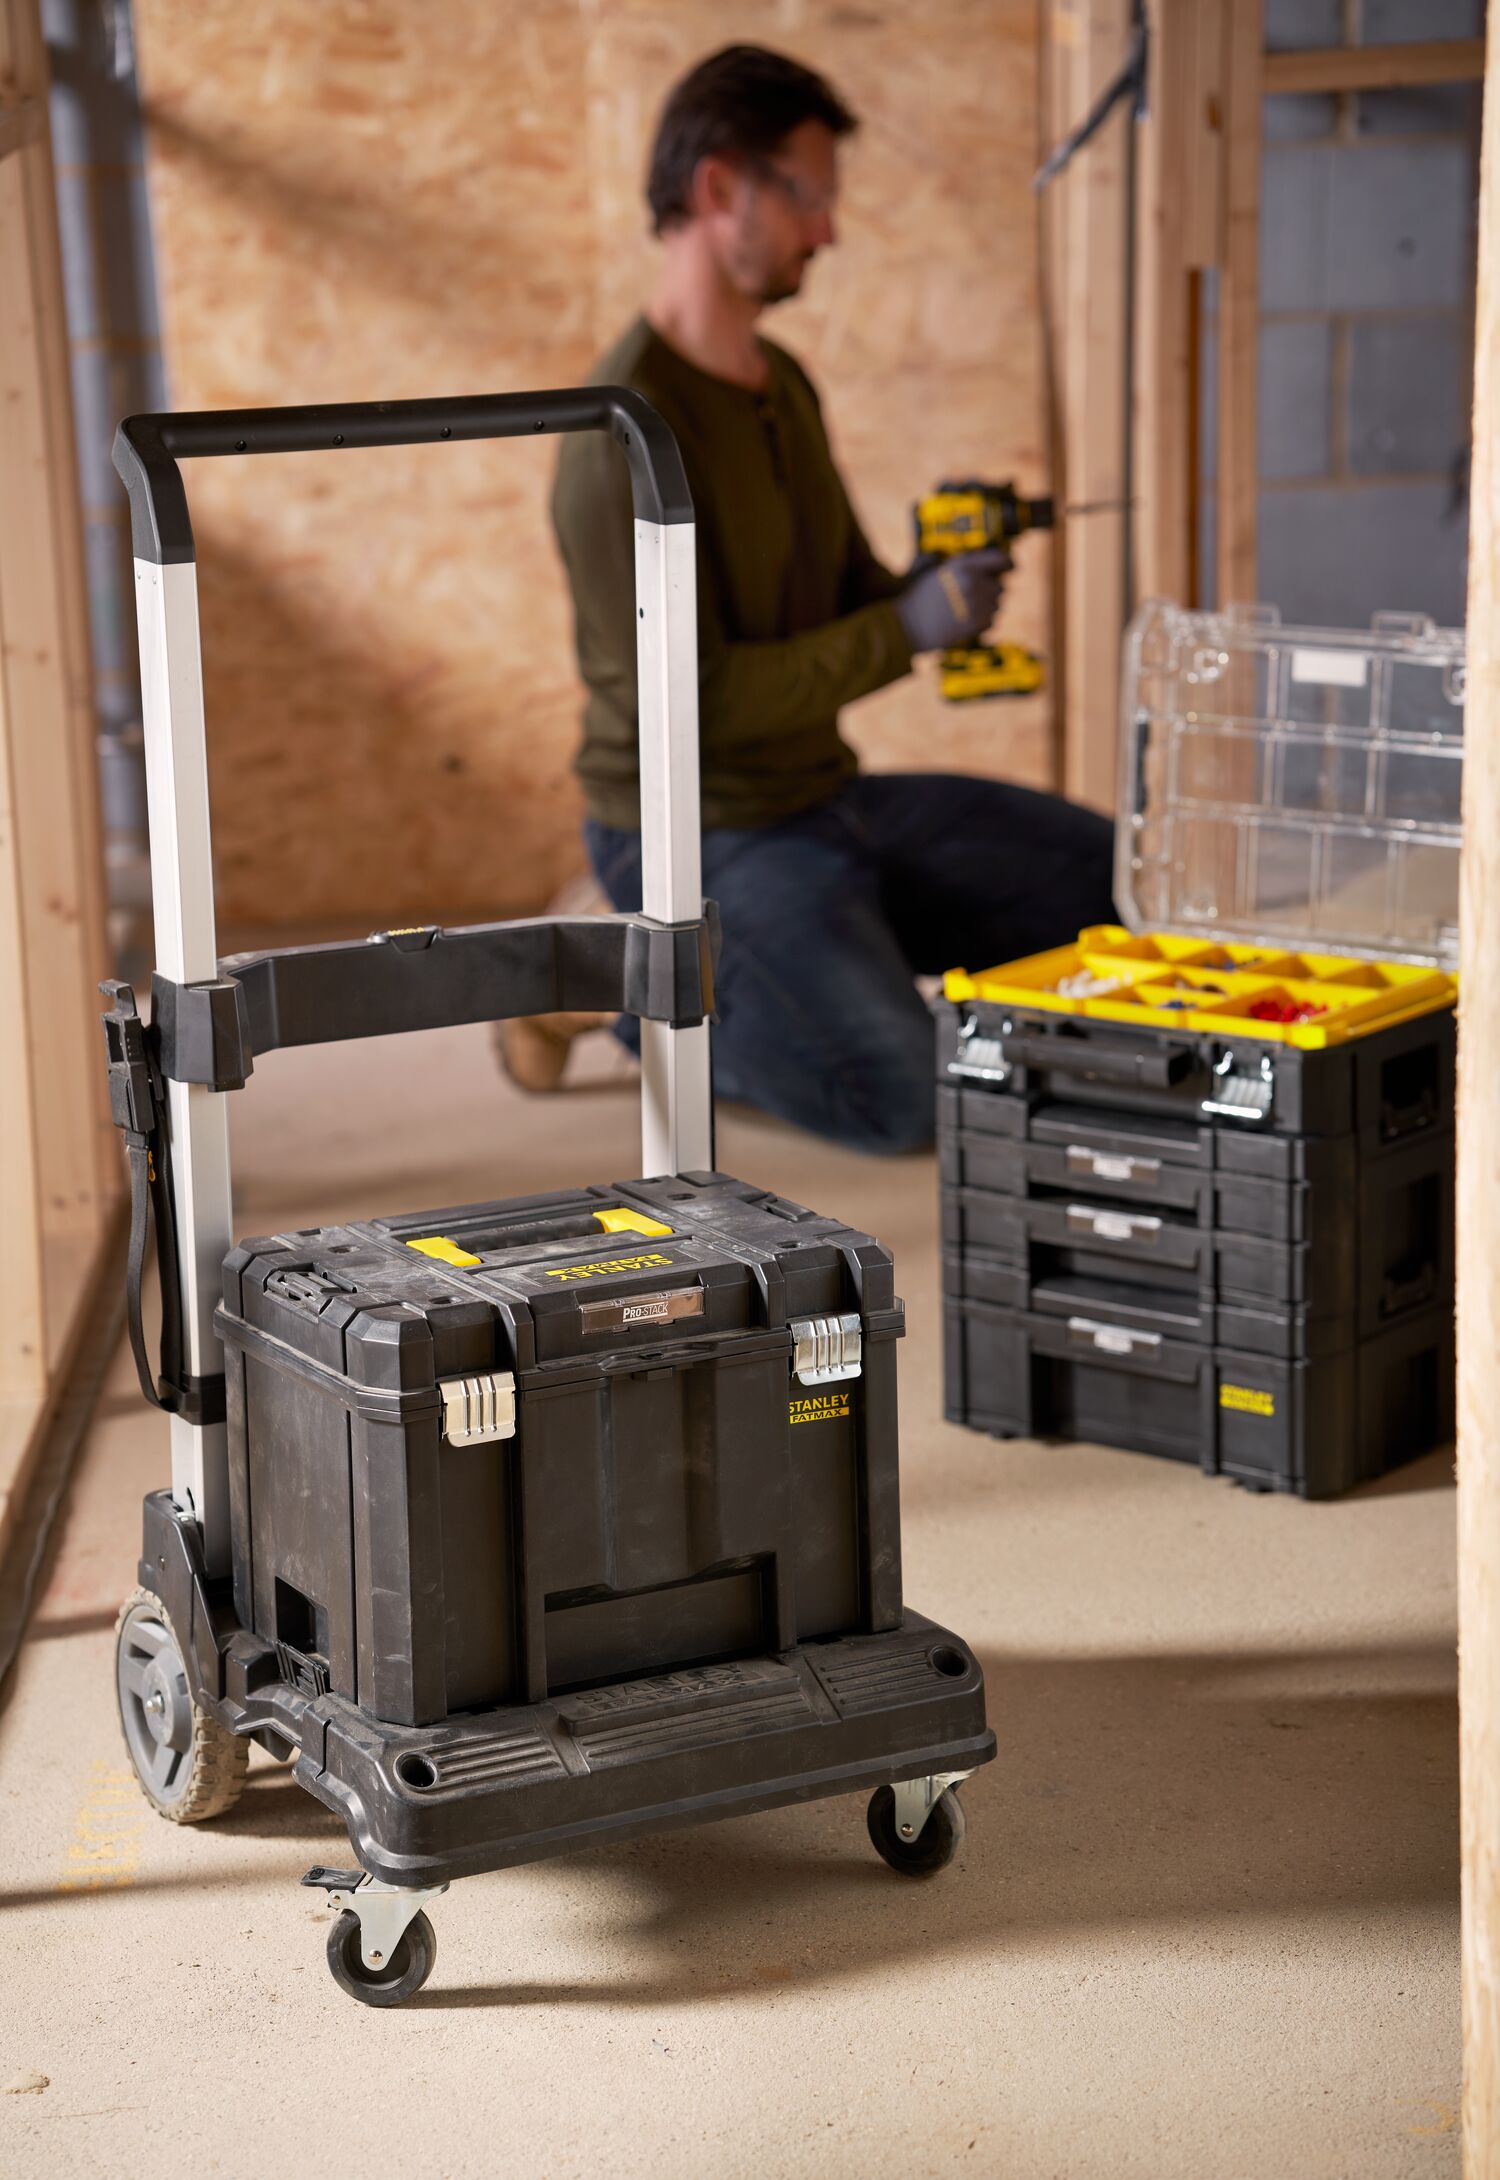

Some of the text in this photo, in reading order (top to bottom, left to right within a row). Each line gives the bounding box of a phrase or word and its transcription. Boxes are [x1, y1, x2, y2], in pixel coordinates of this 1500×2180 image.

[560, 1258, 673, 1281] STANLEY
[789, 1393, 849, 1414] STANLEY
[792, 1408, 843, 1423] FATMAX
